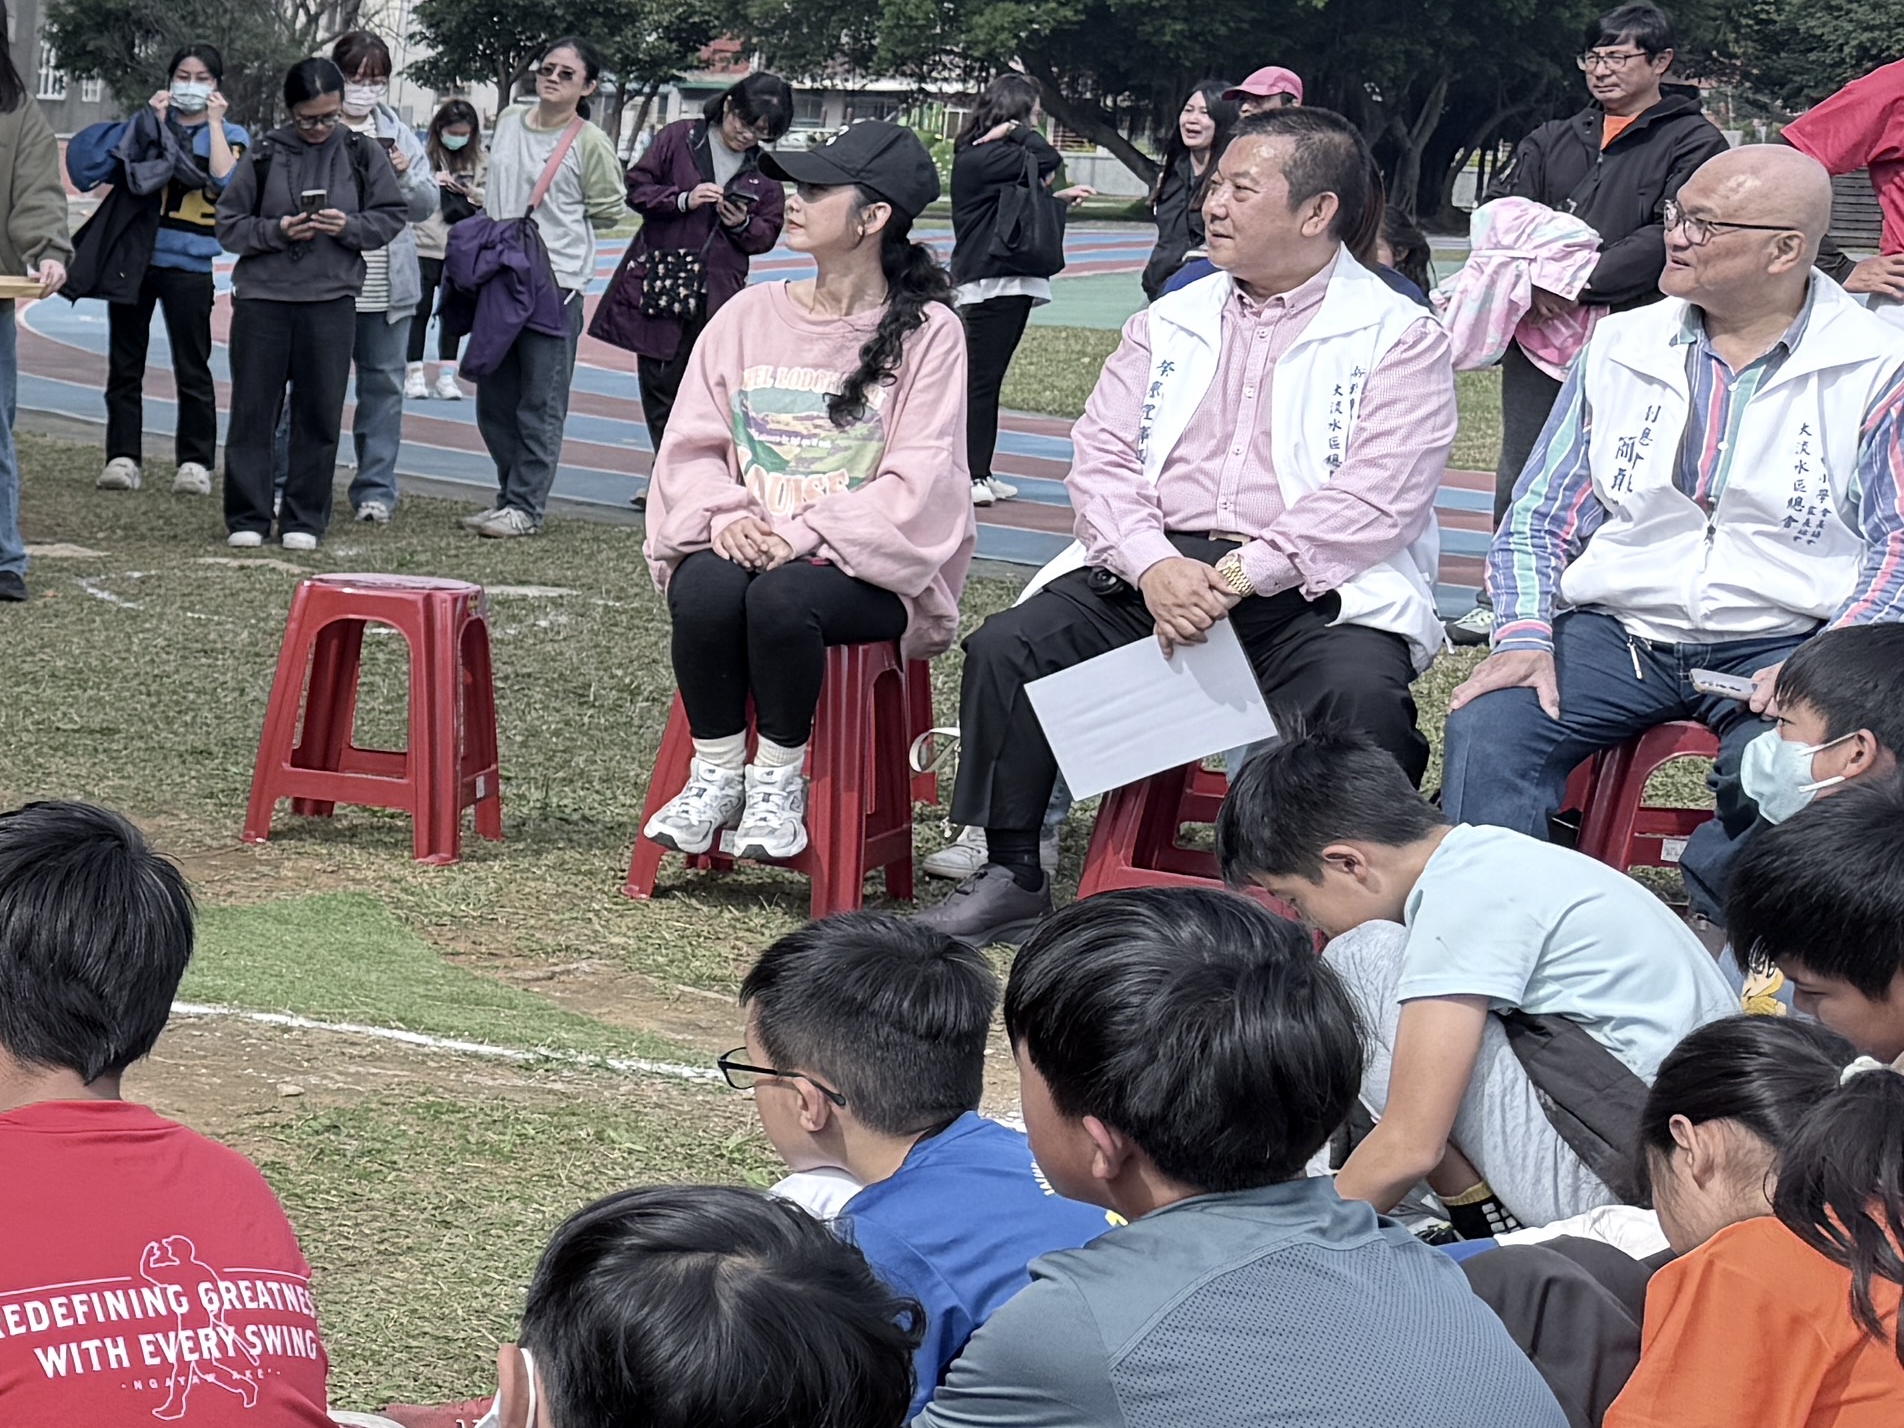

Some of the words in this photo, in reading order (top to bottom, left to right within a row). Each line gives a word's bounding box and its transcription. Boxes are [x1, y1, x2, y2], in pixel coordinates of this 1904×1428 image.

[33, 1336, 131, 1379] WITH
[138, 1326, 237, 1365] EVERY
[244, 1324, 317, 1360] SWING
